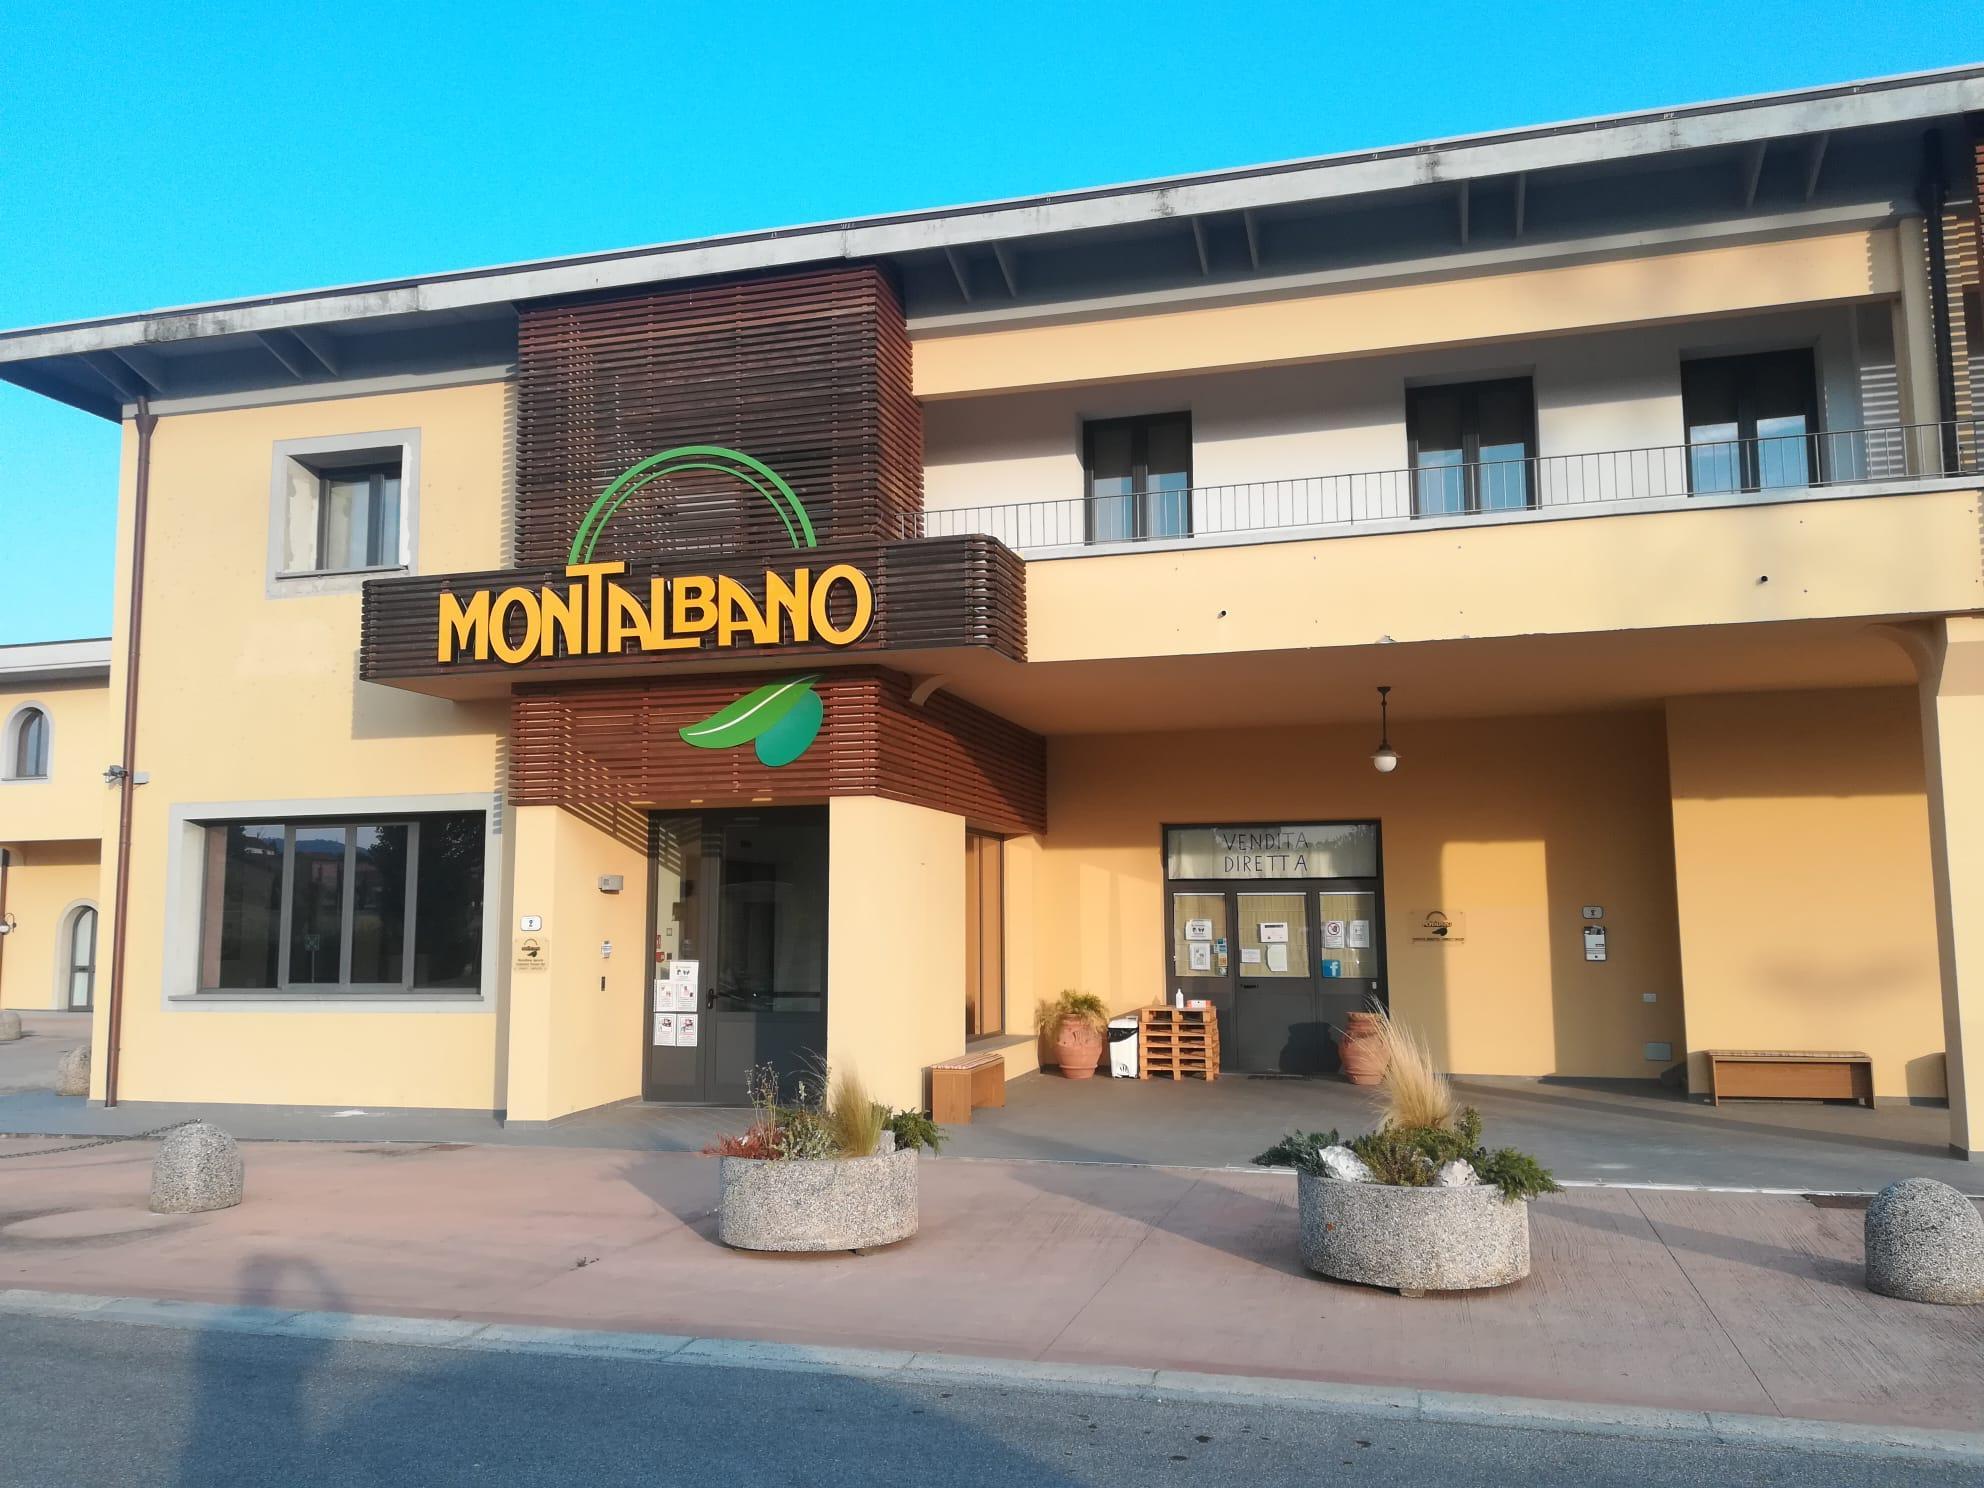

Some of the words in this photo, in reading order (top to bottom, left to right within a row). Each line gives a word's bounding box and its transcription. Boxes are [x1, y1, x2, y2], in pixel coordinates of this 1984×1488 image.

[437, 560, 873, 664] MONTALBANO
[1223, 832, 1309, 851] VENDITA
[1224, 854, 1308, 872] DIRETTA
